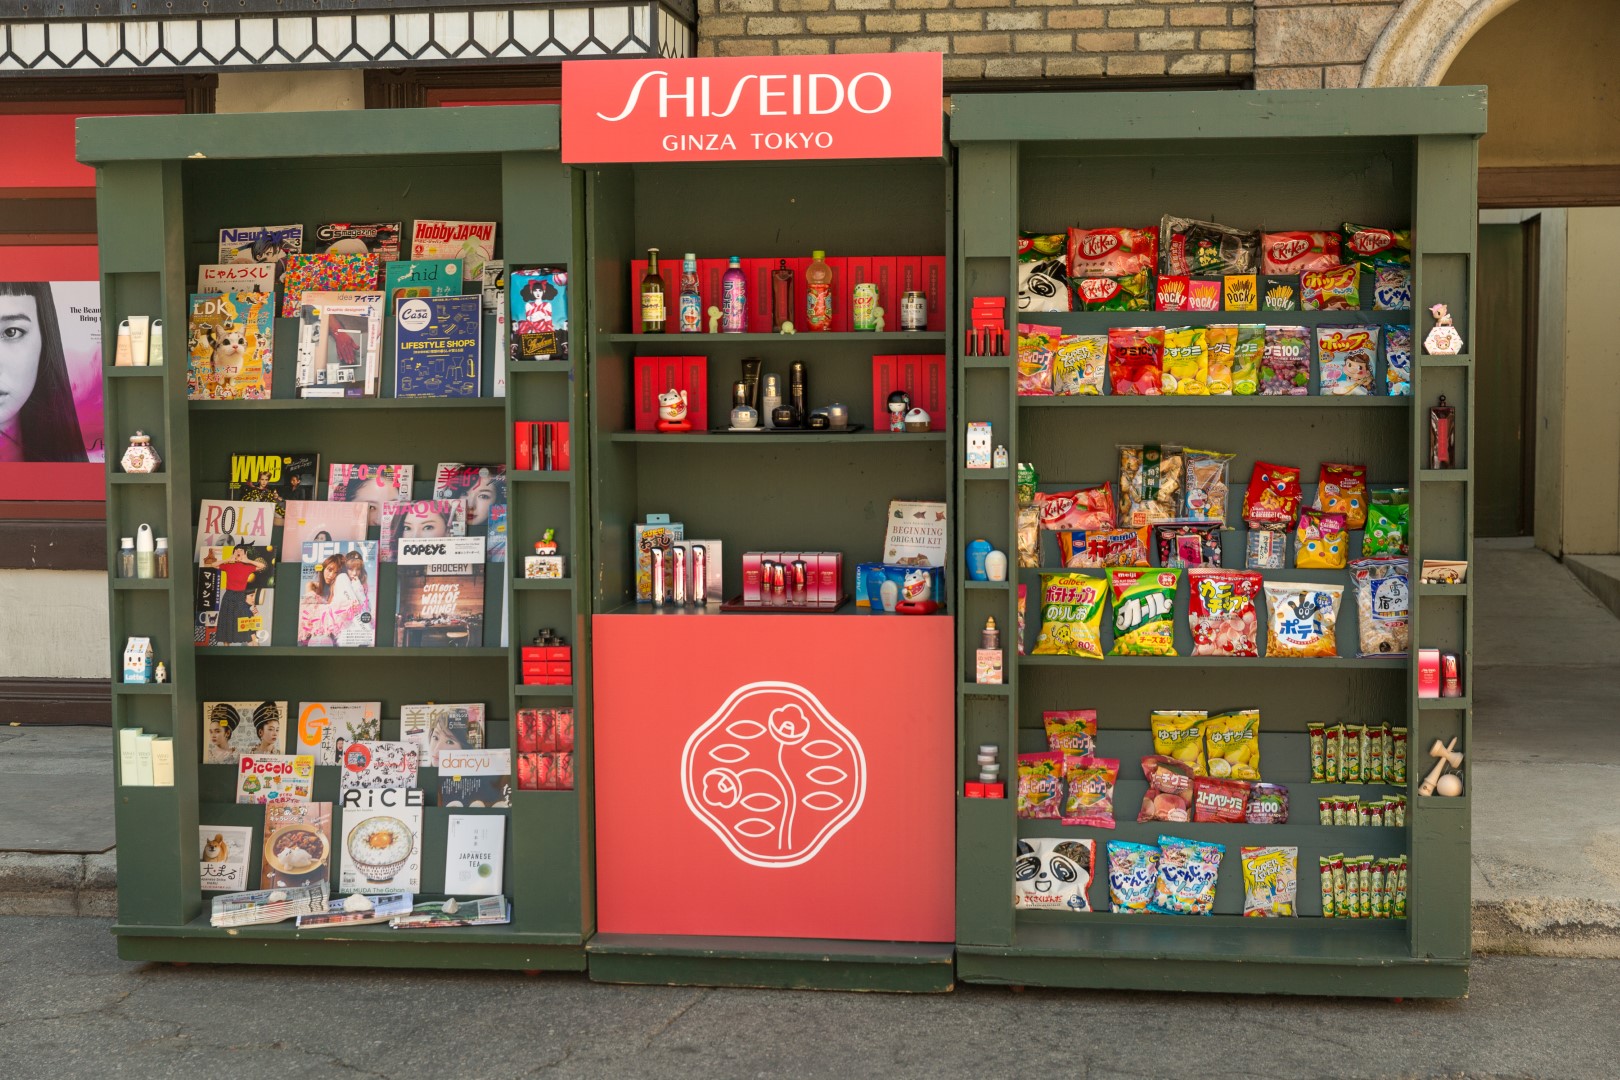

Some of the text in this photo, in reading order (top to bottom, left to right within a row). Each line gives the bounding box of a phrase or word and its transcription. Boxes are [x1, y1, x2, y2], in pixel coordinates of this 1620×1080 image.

[596, 70, 892, 122] SHISEIDO
[662, 131, 833, 151] GINZA TOKYO
[221, 228, 301, 244] Newtype
[415, 223, 493, 243] Hobby JAPAN
[1088, 235, 1114, 256] KitKat
[1359, 234, 1387, 251] KitKat
[205, 267, 269, 279] にゃんづくし
[410, 264, 439, 282] nid
[338, 293, 382, 303] idea アイデア
[193, 299, 230, 316] LDK
[402, 308, 428, 320] Casa
[80, 315, 98, 323] Bring
[401, 339, 476, 350] LIFESTYLE SHOPS
[1322, 332, 1367, 351] ポップ
[231, 455, 282, 483] WWD
[437, 466, 481, 491] 美的
[1044, 498, 1072, 518] KitKat
[204, 504, 266, 537] ROLA
[892, 525, 943, 536] BEGINNING
[890, 535, 942, 545] ORIGAMI KIT
[403, 543, 447, 556] POPEYE
[431, 563, 469, 573] GROCERY
[202, 571, 212, 607] マッシュ
[423, 584, 440, 592] CITY
[1058, 577, 1086, 586] Calbee
[421, 591, 461, 605] WAY OF
[1207, 595, 1248, 613] チップ
[1047, 605, 1087, 621] のりしお
[1115, 592, 1173, 631] カール
[1279, 618, 1324, 639] ポテコ
[1158, 728, 1199, 740] ゆずグミ
[1211, 730, 1253, 743] ゆずグミ
[241, 757, 293, 774] Piccolo
[441, 753, 491, 771] dancyu
[1197, 790, 1243, 810] ストロベリーグミ
[1248, 859, 1279, 875] SUPER
